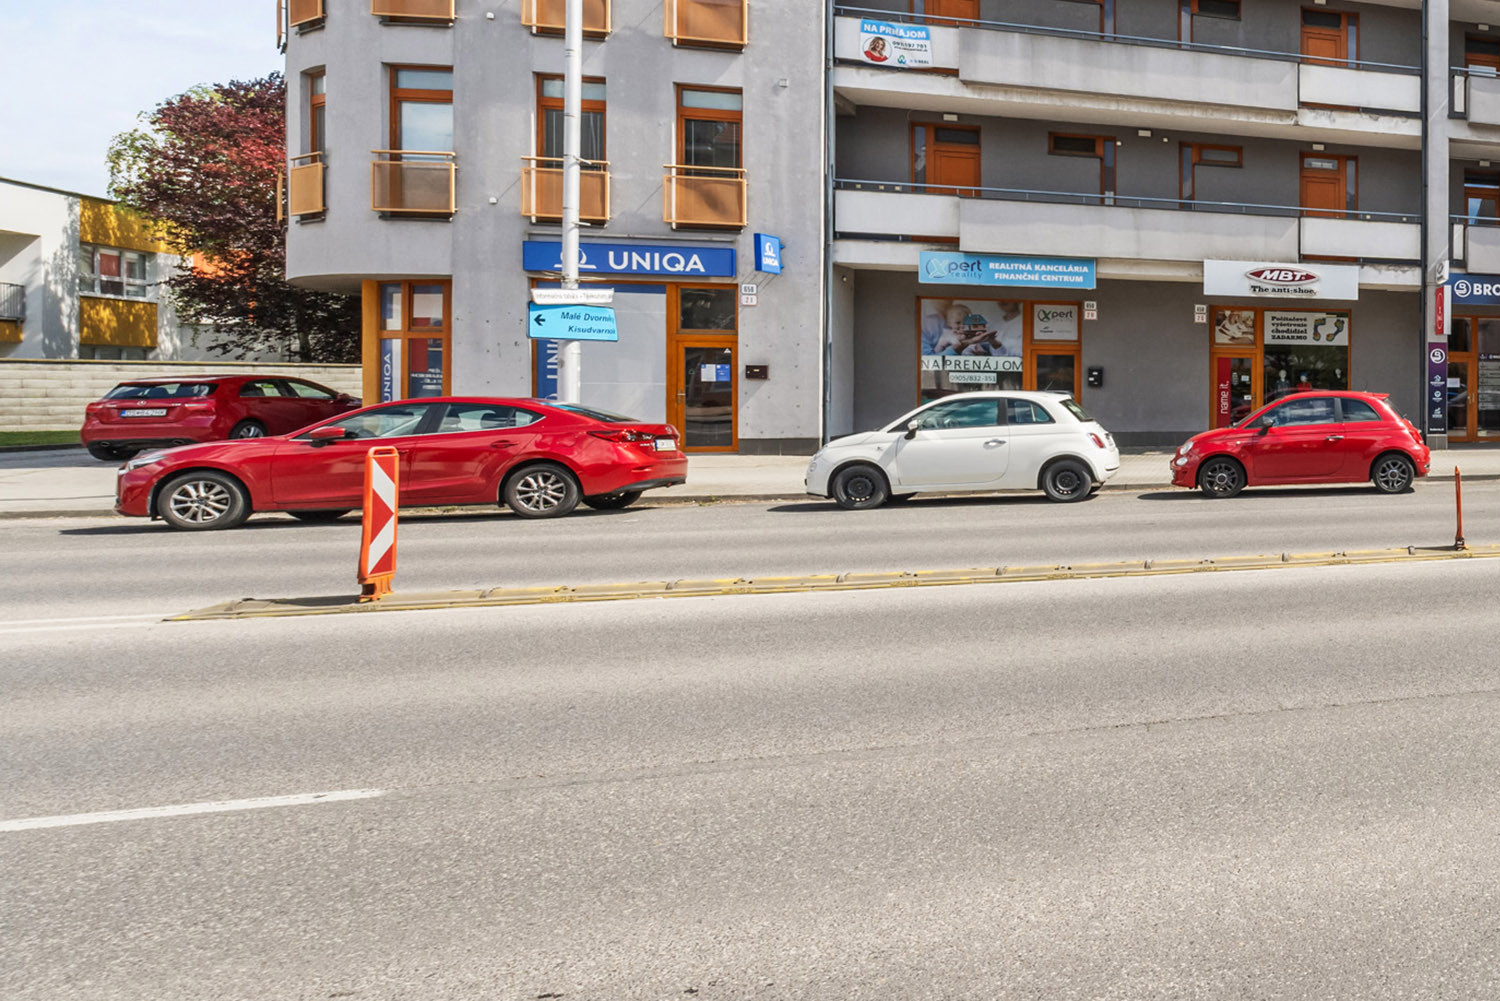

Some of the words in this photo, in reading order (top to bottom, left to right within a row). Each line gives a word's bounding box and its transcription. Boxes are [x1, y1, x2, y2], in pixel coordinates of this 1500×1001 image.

[864, 24, 878, 32] NA
[608, 250, 706, 273] UNIQA
[989, 262, 1032, 271] REALITNÁ
[1034, 264, 1089, 273] KANCELÁRIA
[994, 272, 1039, 280] FINANČNÉ
[1041, 274, 1084, 282] CENTRUM
[1260, 270, 1304, 281] MBT
[560, 312, 582, 320] Malé
[922, 360, 940, 369] NA
[945, 358, 1022, 370] PRENÁJOM
[1220, 390, 1228, 414] name
